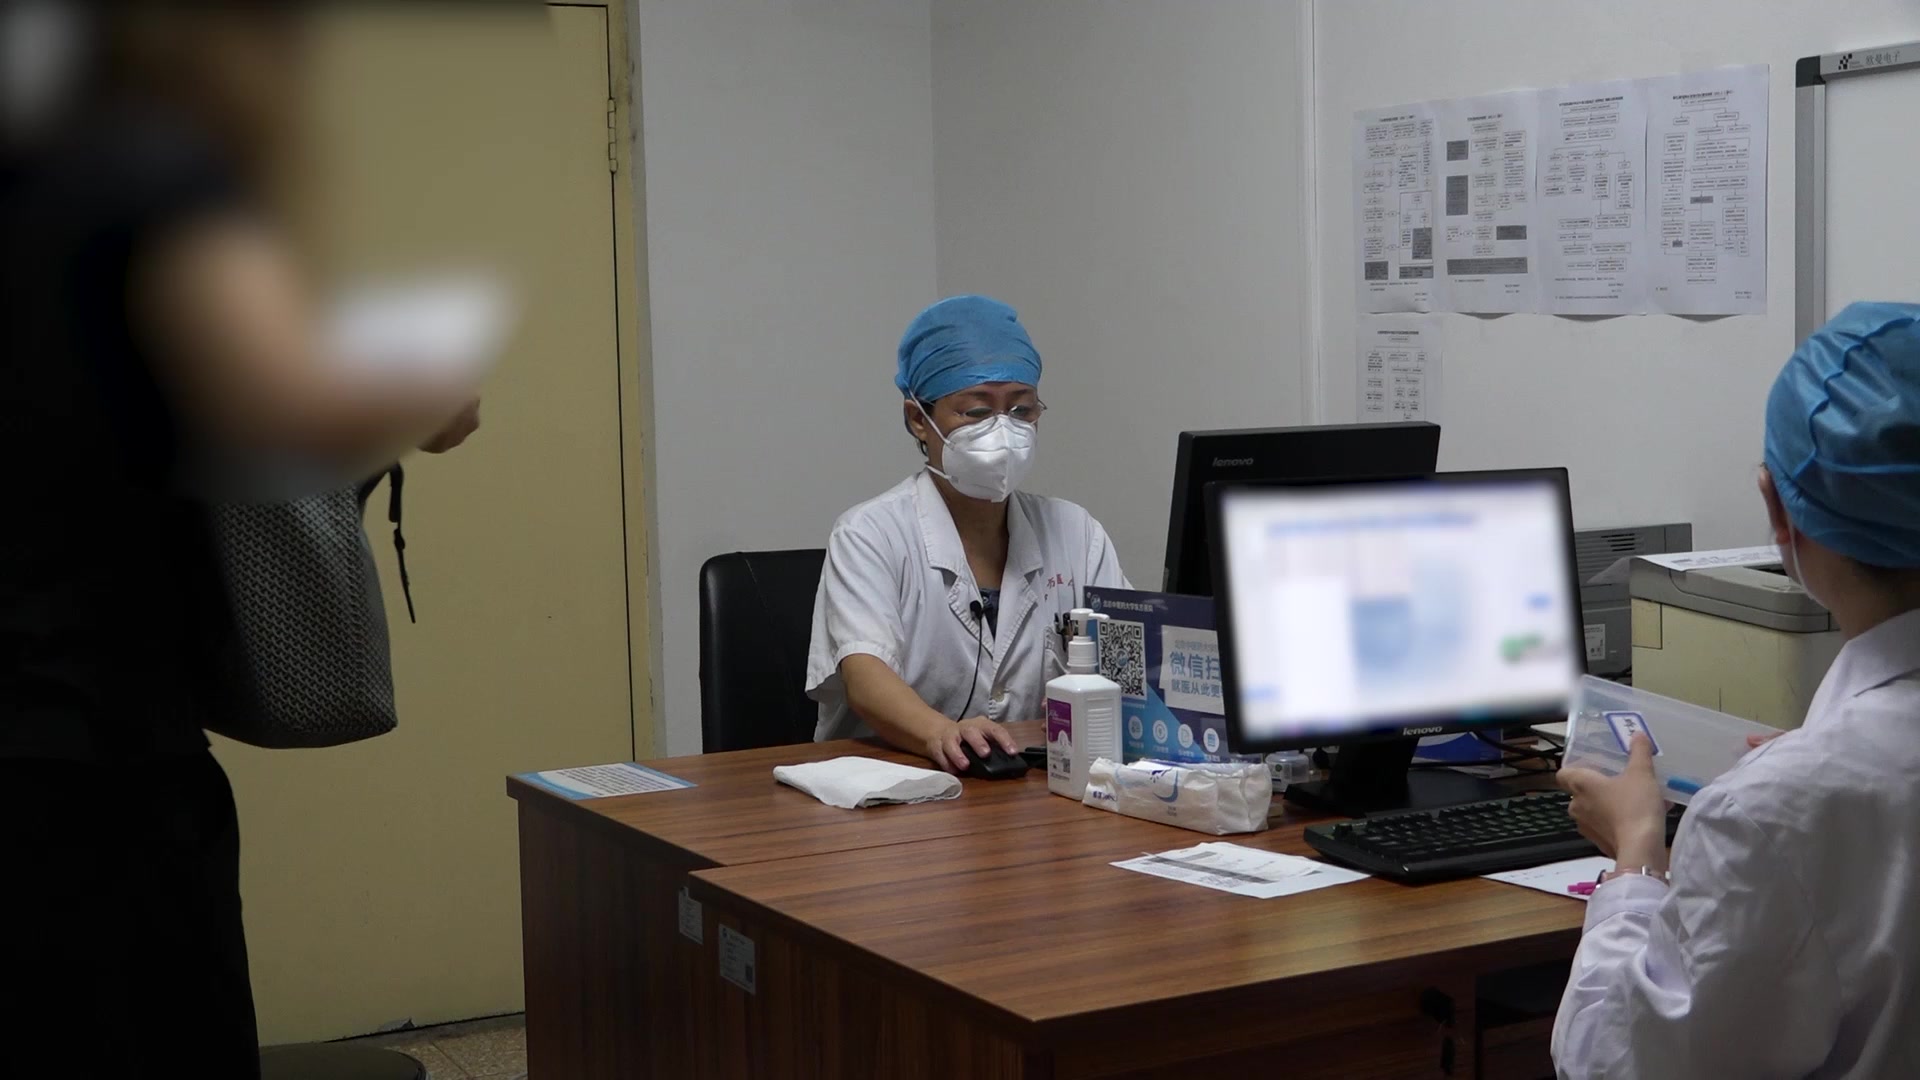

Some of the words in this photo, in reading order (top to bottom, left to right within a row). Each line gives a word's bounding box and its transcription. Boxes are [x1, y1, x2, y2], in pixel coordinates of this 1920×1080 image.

[1212, 457, 1254, 467] lenovo
[1170, 651, 1221, 680] 微信扫
[1171, 679, 1222, 698] 就医从此更
[1403, 726, 1443, 736] lenovo
